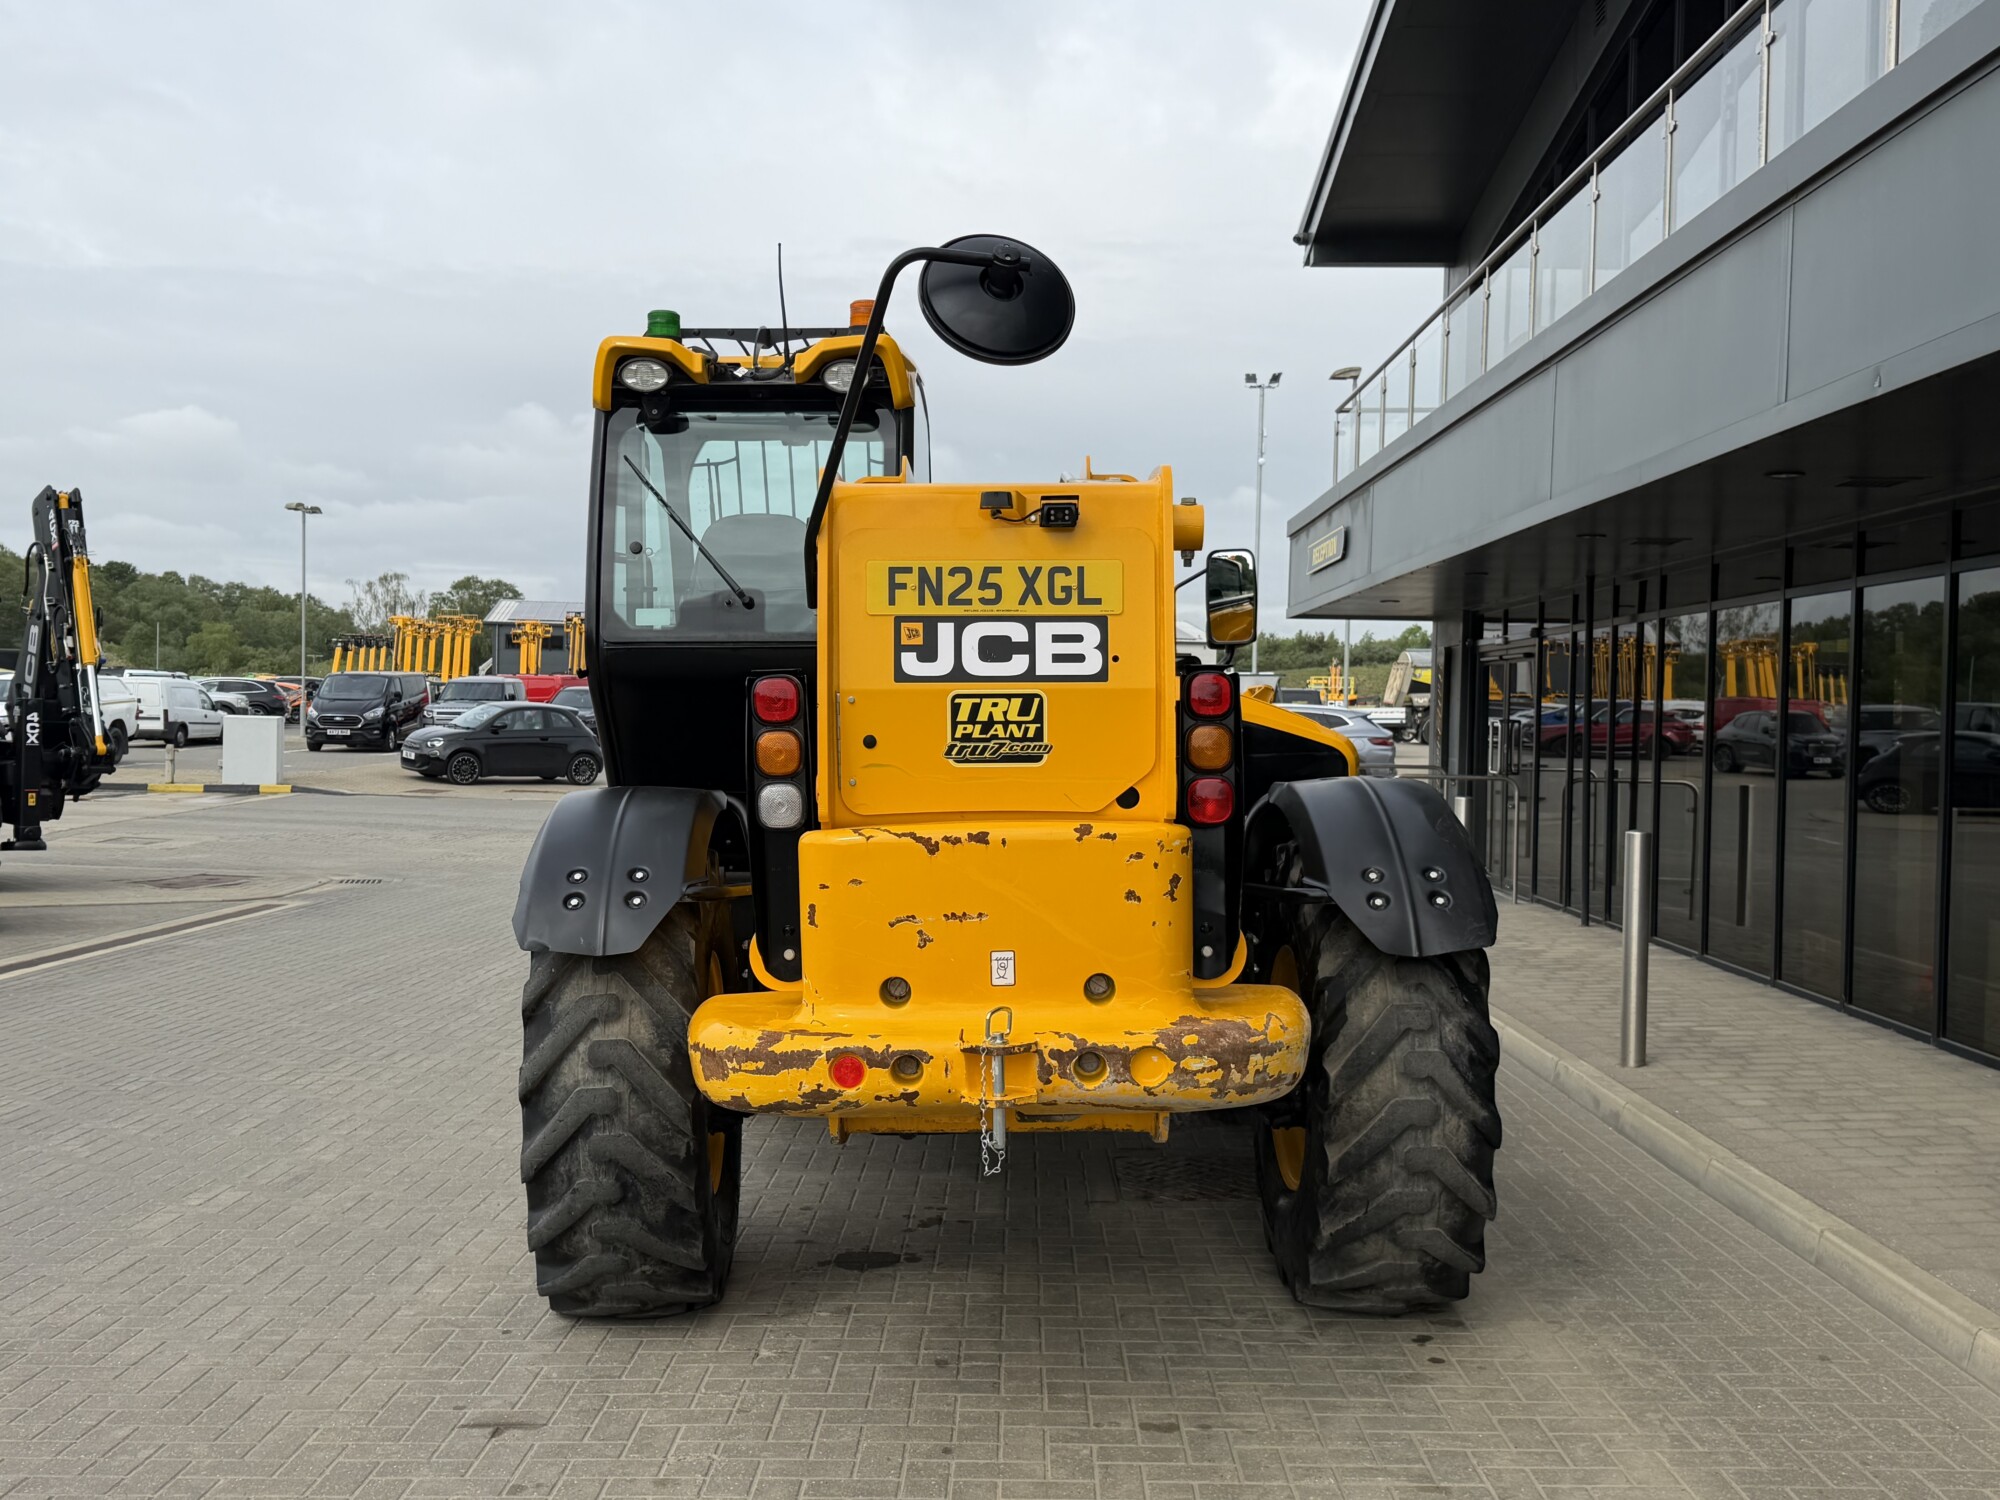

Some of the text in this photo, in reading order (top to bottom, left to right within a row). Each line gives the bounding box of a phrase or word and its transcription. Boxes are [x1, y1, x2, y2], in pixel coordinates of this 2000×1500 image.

[1312, 536, 1338, 566] RECEPTION
[888, 566, 1102, 606] FN25 XGL
[903, 626, 921, 641] JCB
[22, 624, 39, 699] JCB
[901, 622, 1103, 677] JCB
[954, 697, 1041, 722] TRU
[26, 711, 40, 744] 4CX
[954, 723, 1041, 738] PLANT
[943, 740, 1053, 759] tru7.com
